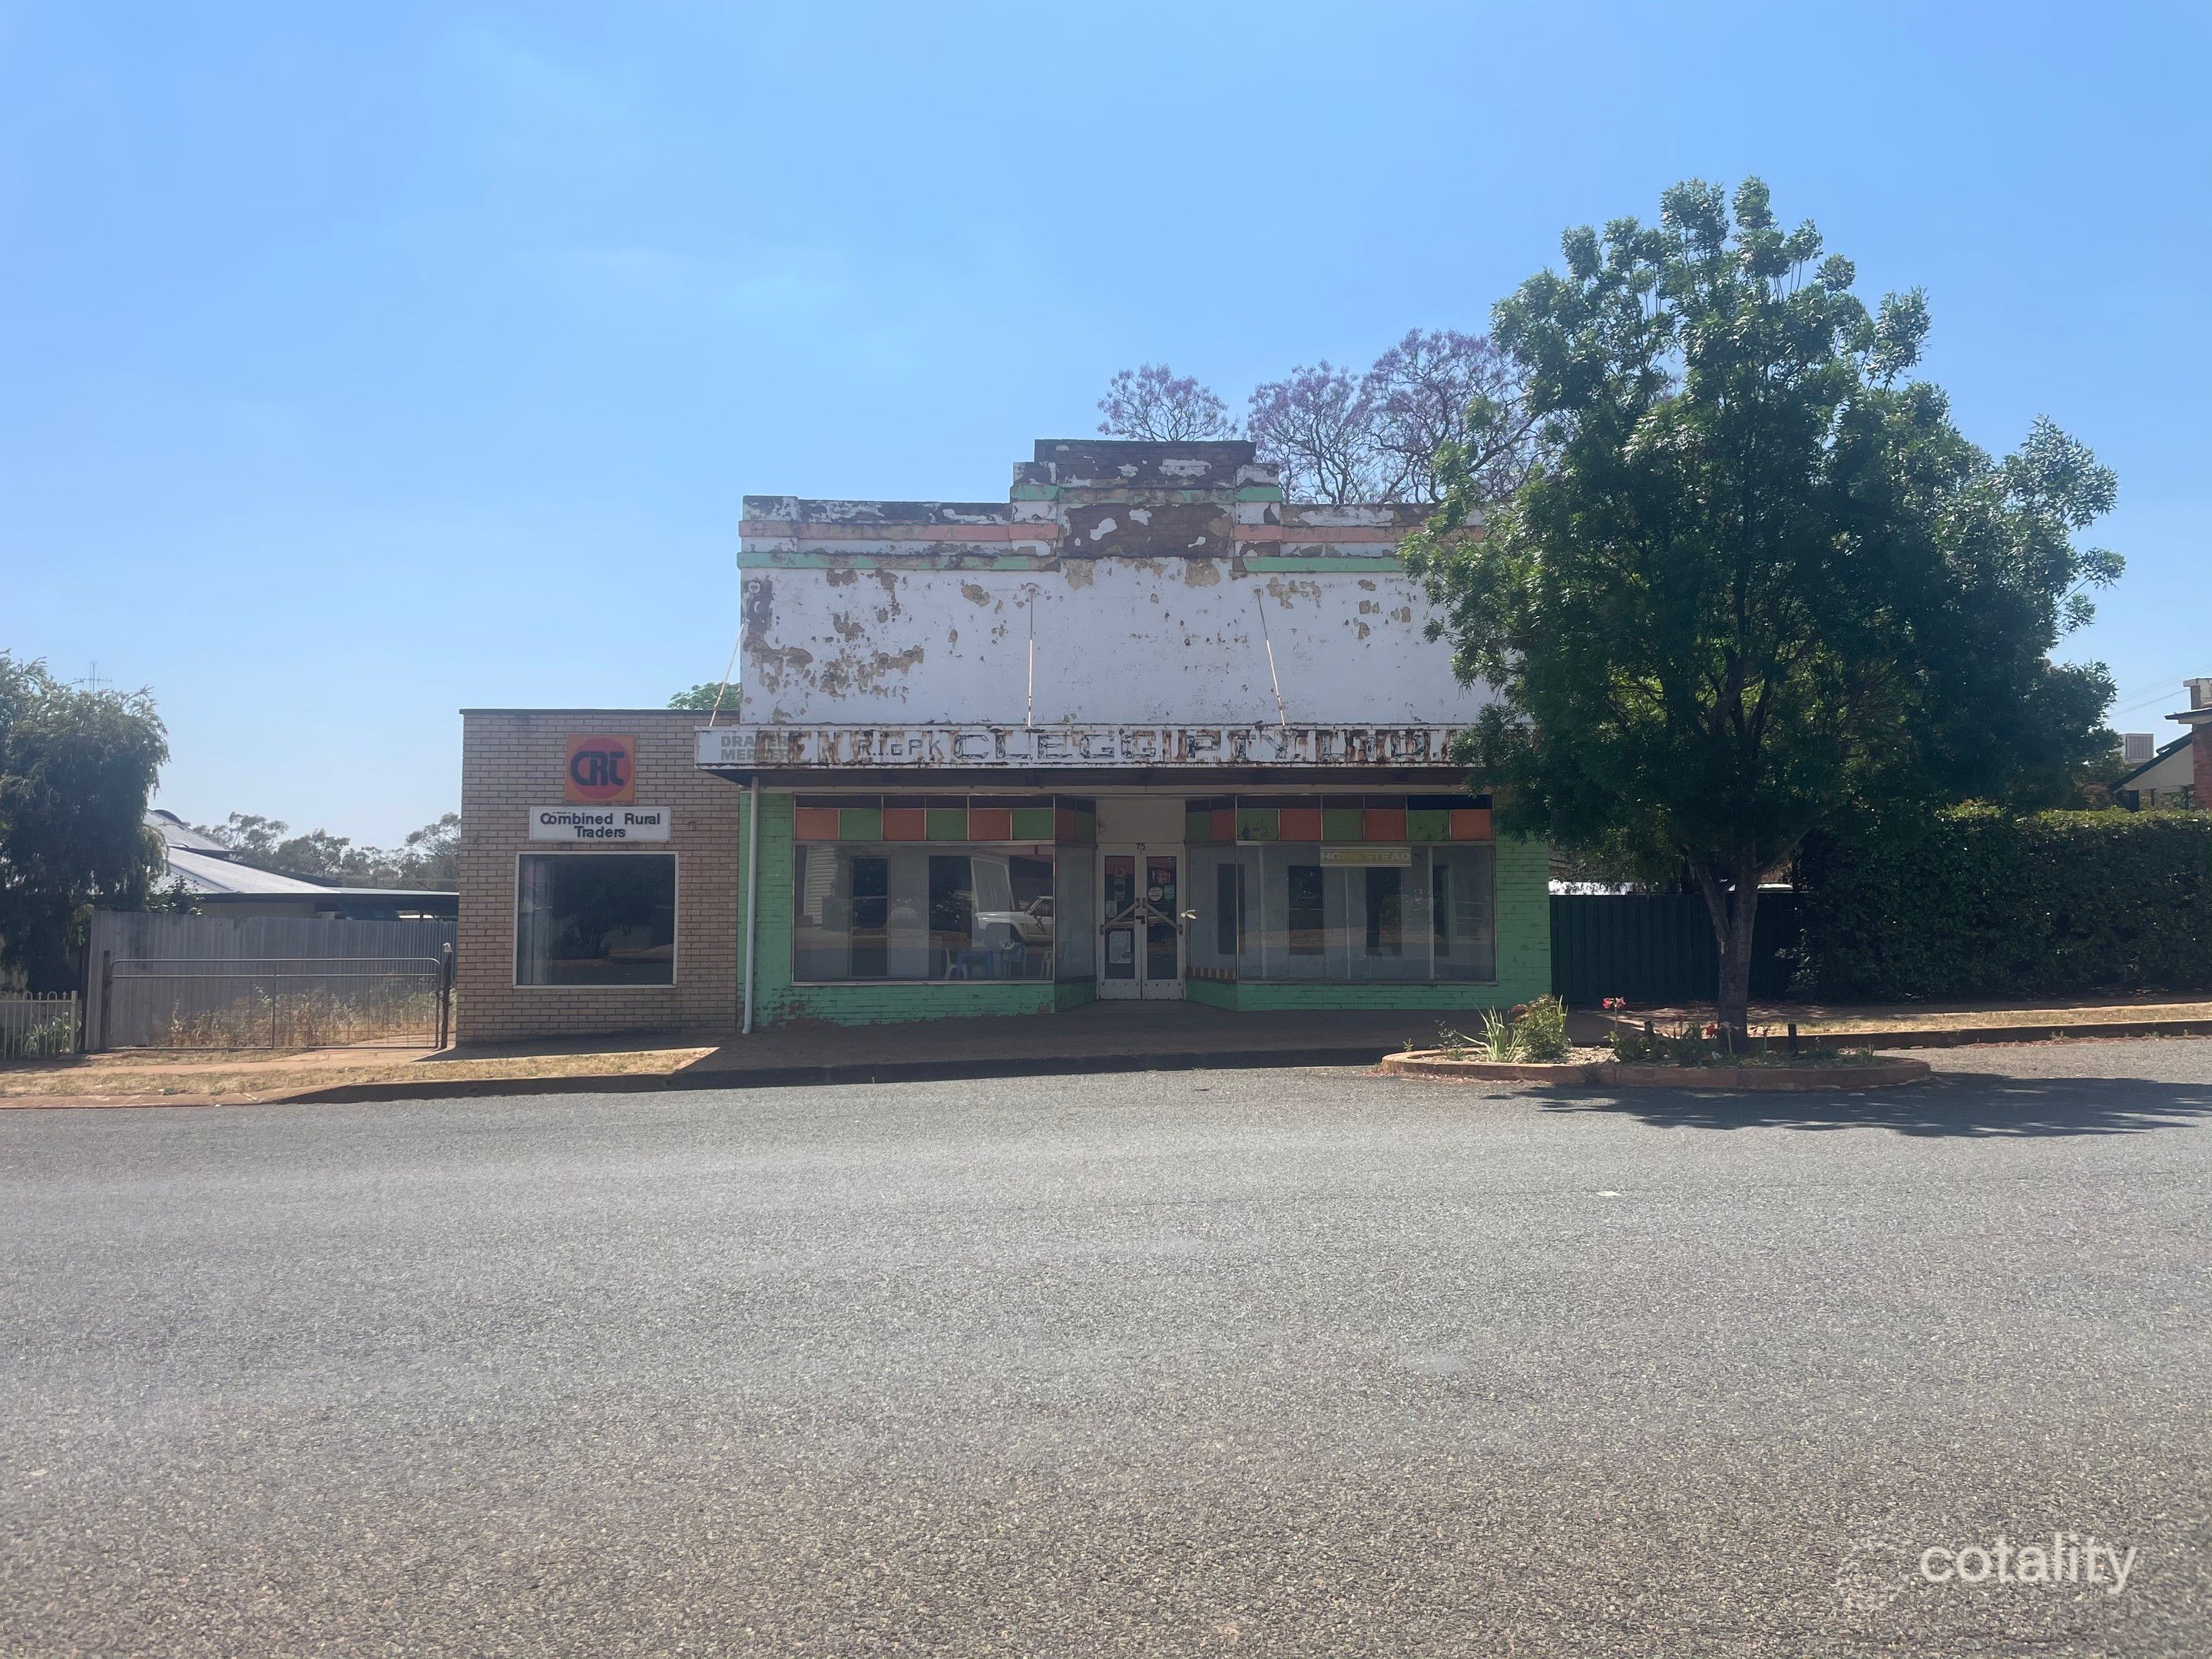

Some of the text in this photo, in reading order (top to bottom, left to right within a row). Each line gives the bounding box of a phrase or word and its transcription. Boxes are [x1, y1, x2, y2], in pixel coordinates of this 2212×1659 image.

[571, 750, 624, 786] CRT
[540, 813, 661, 825] Combined Rural
[574, 826, 626, 838] Traders
[1137, 843, 1146, 851] 75
